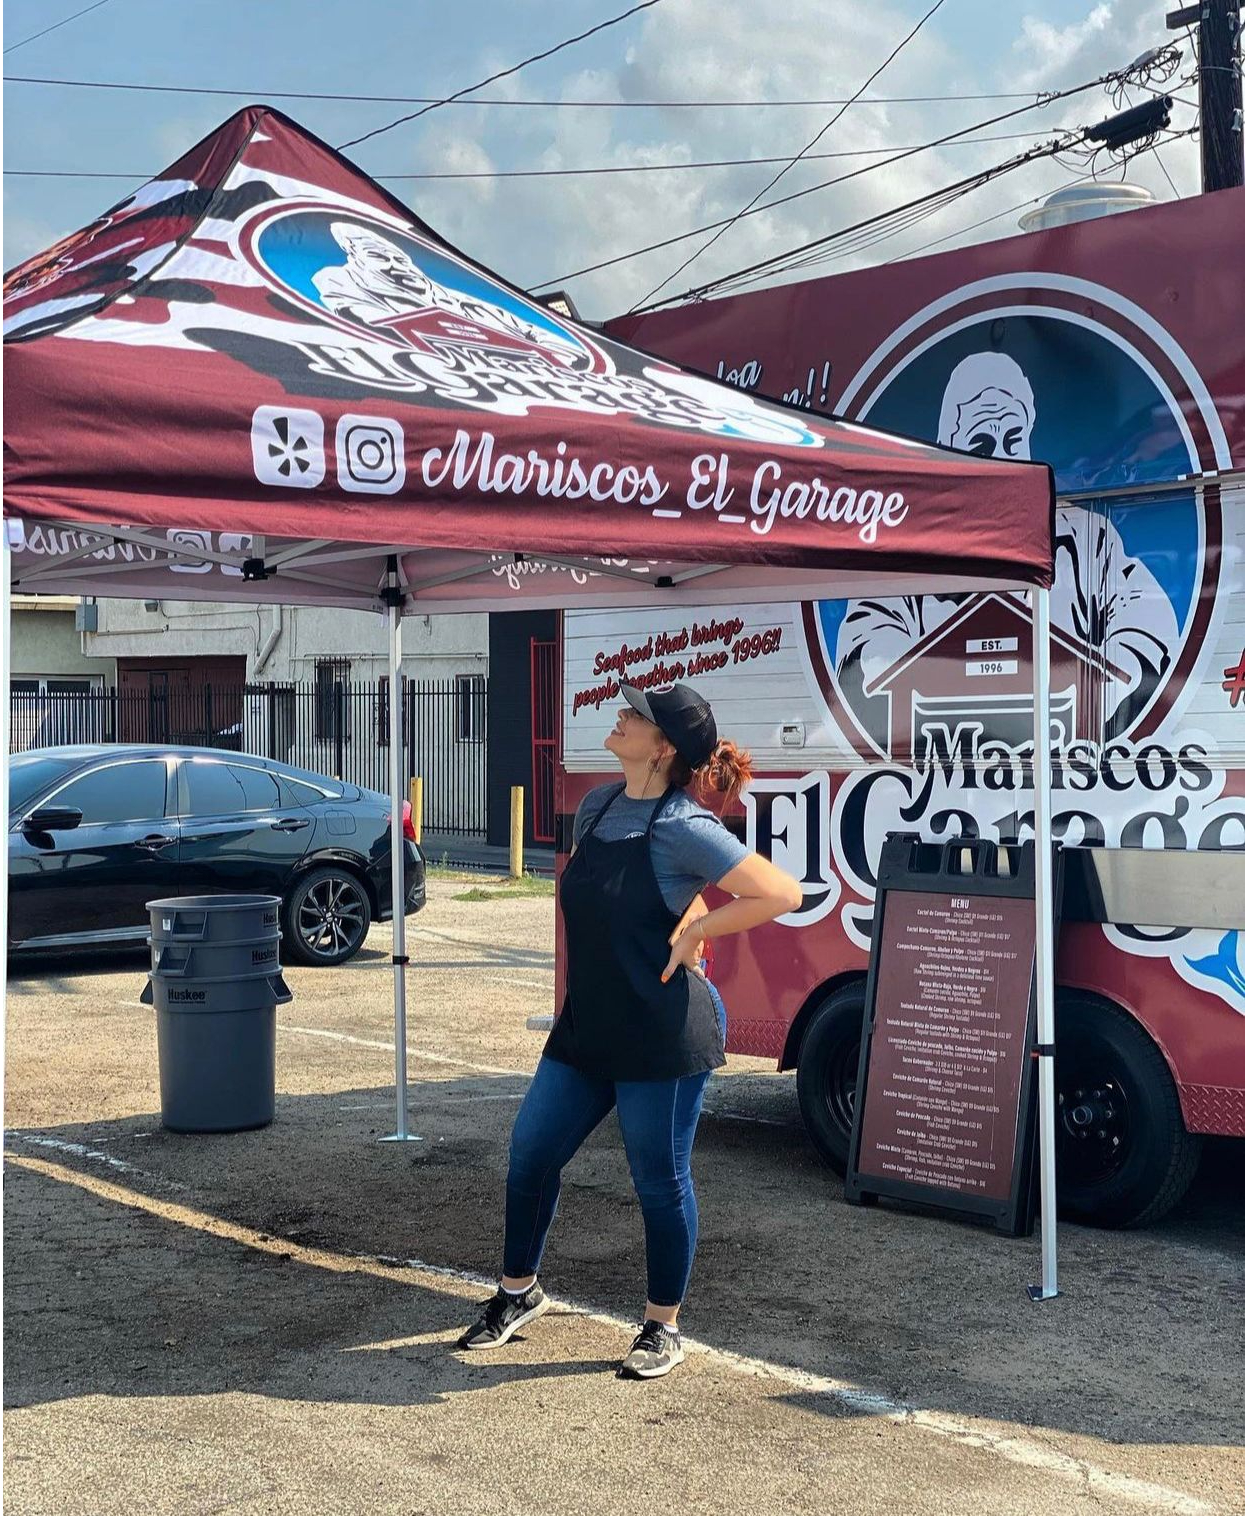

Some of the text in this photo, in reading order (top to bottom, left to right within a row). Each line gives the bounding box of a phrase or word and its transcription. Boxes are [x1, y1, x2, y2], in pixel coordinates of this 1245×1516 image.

[421, 430, 909, 544] Mariscos_El_Garage
[572, 627, 783, 717] people together since 1996!!
[593, 617, 744, 677] Seafood that brings
[980, 662, 1003, 674] 1996
[981, 640, 1003, 651] EST.
[904, 725, 1214, 808] Mariscos
[167, 987, 206, 1001] Huskee
